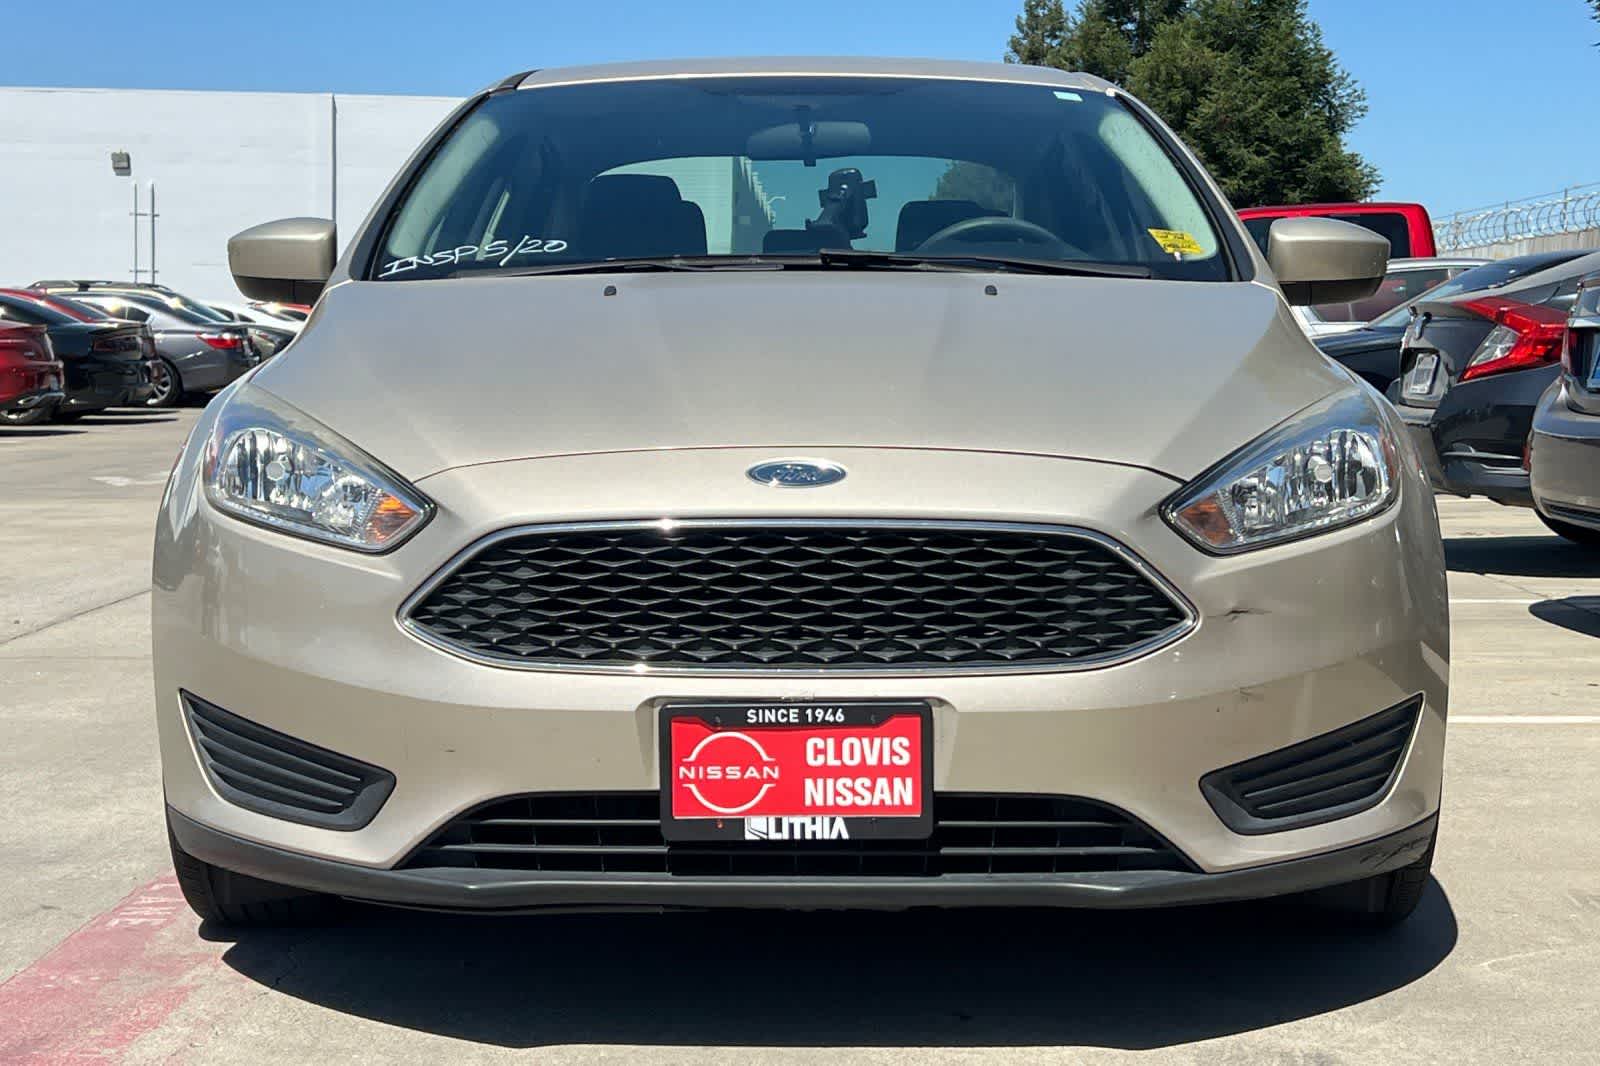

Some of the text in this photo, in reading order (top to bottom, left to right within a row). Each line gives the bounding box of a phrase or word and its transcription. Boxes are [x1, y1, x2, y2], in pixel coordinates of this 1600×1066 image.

[378, 245, 478, 278] INSP
[746, 708, 845, 724] SINCE 1946
[805, 736, 911, 767] CLOVIS
[679, 765, 780, 780] NISSAN
[804, 777, 913, 807] NISSAN
[768, 816, 849, 840] LITHIA
